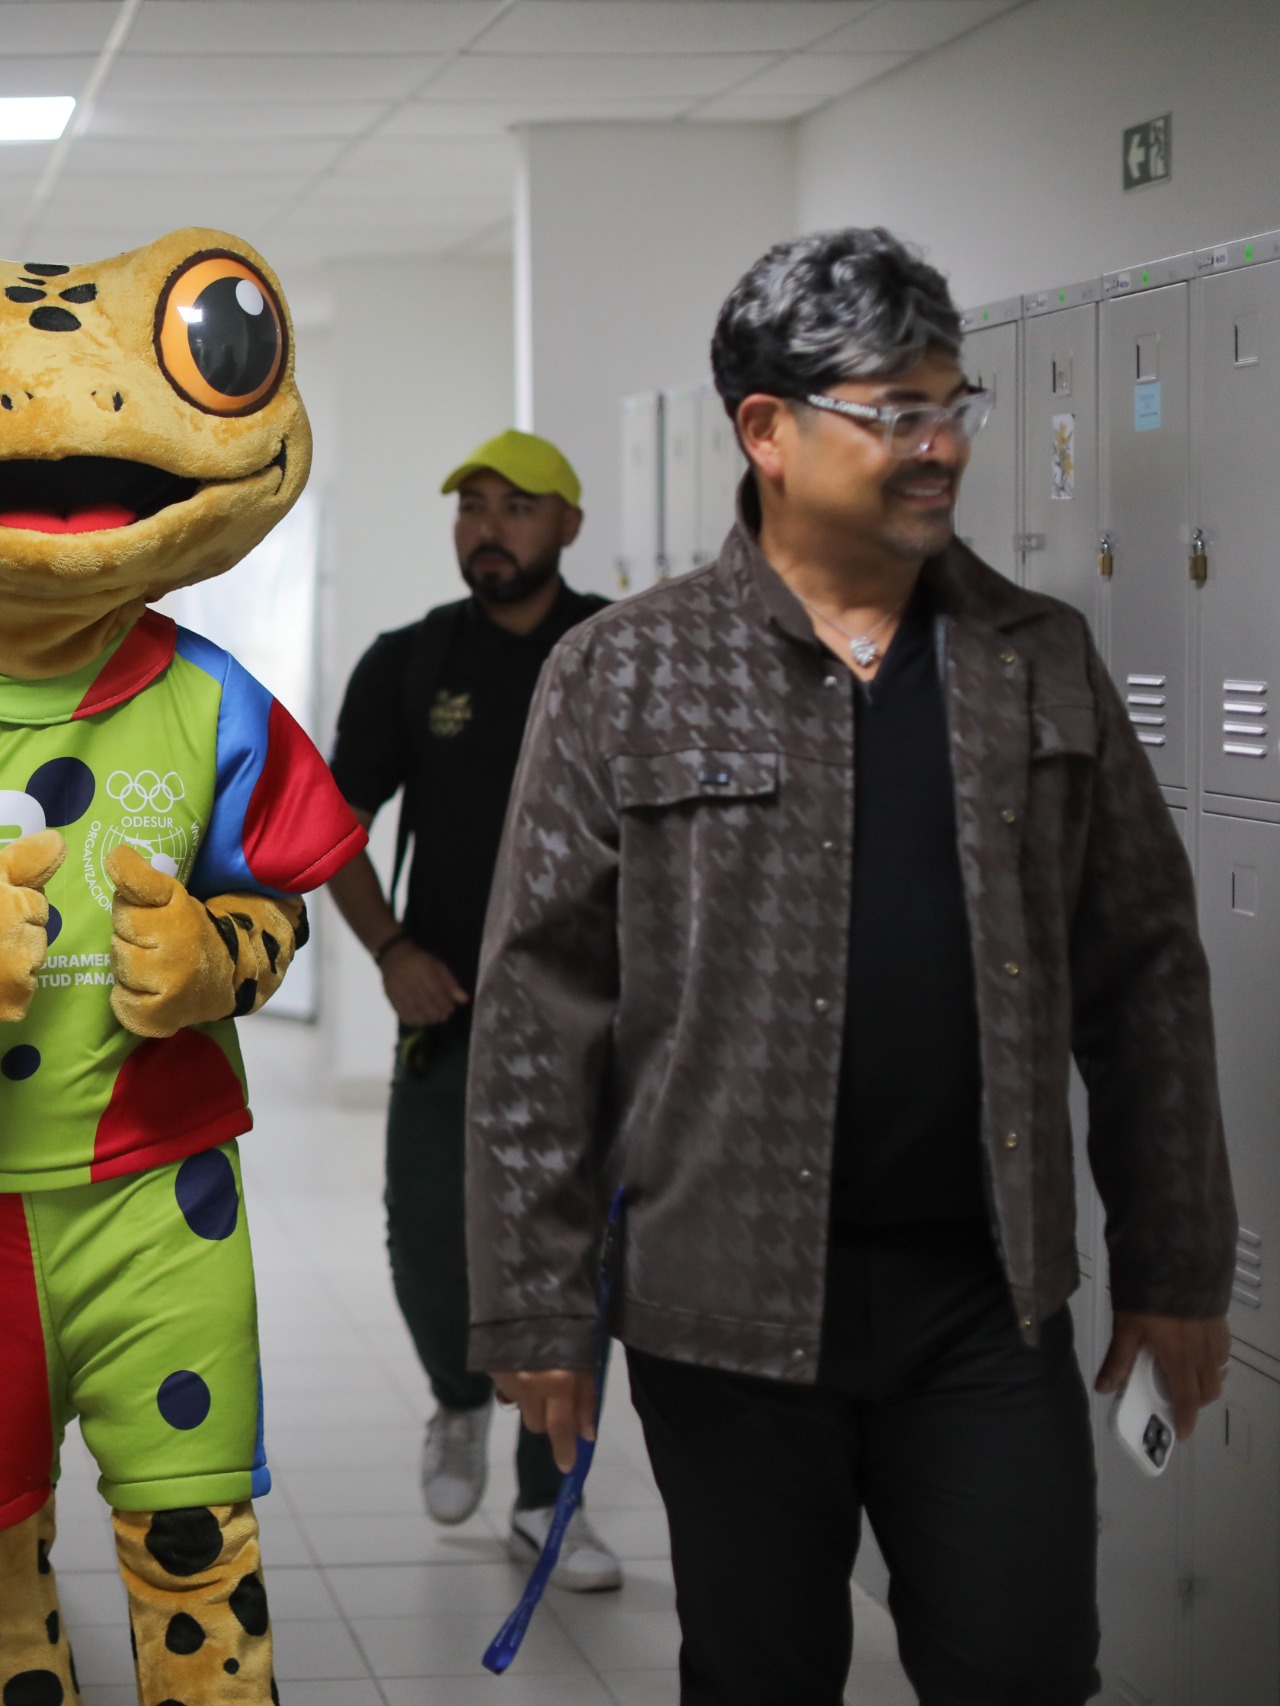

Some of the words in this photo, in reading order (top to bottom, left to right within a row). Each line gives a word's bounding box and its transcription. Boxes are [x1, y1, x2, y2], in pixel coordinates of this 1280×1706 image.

[121, 816, 174, 828] ODESUR
[36, 973, 72, 988] TUD
[74, 972, 117, 986] PANA
